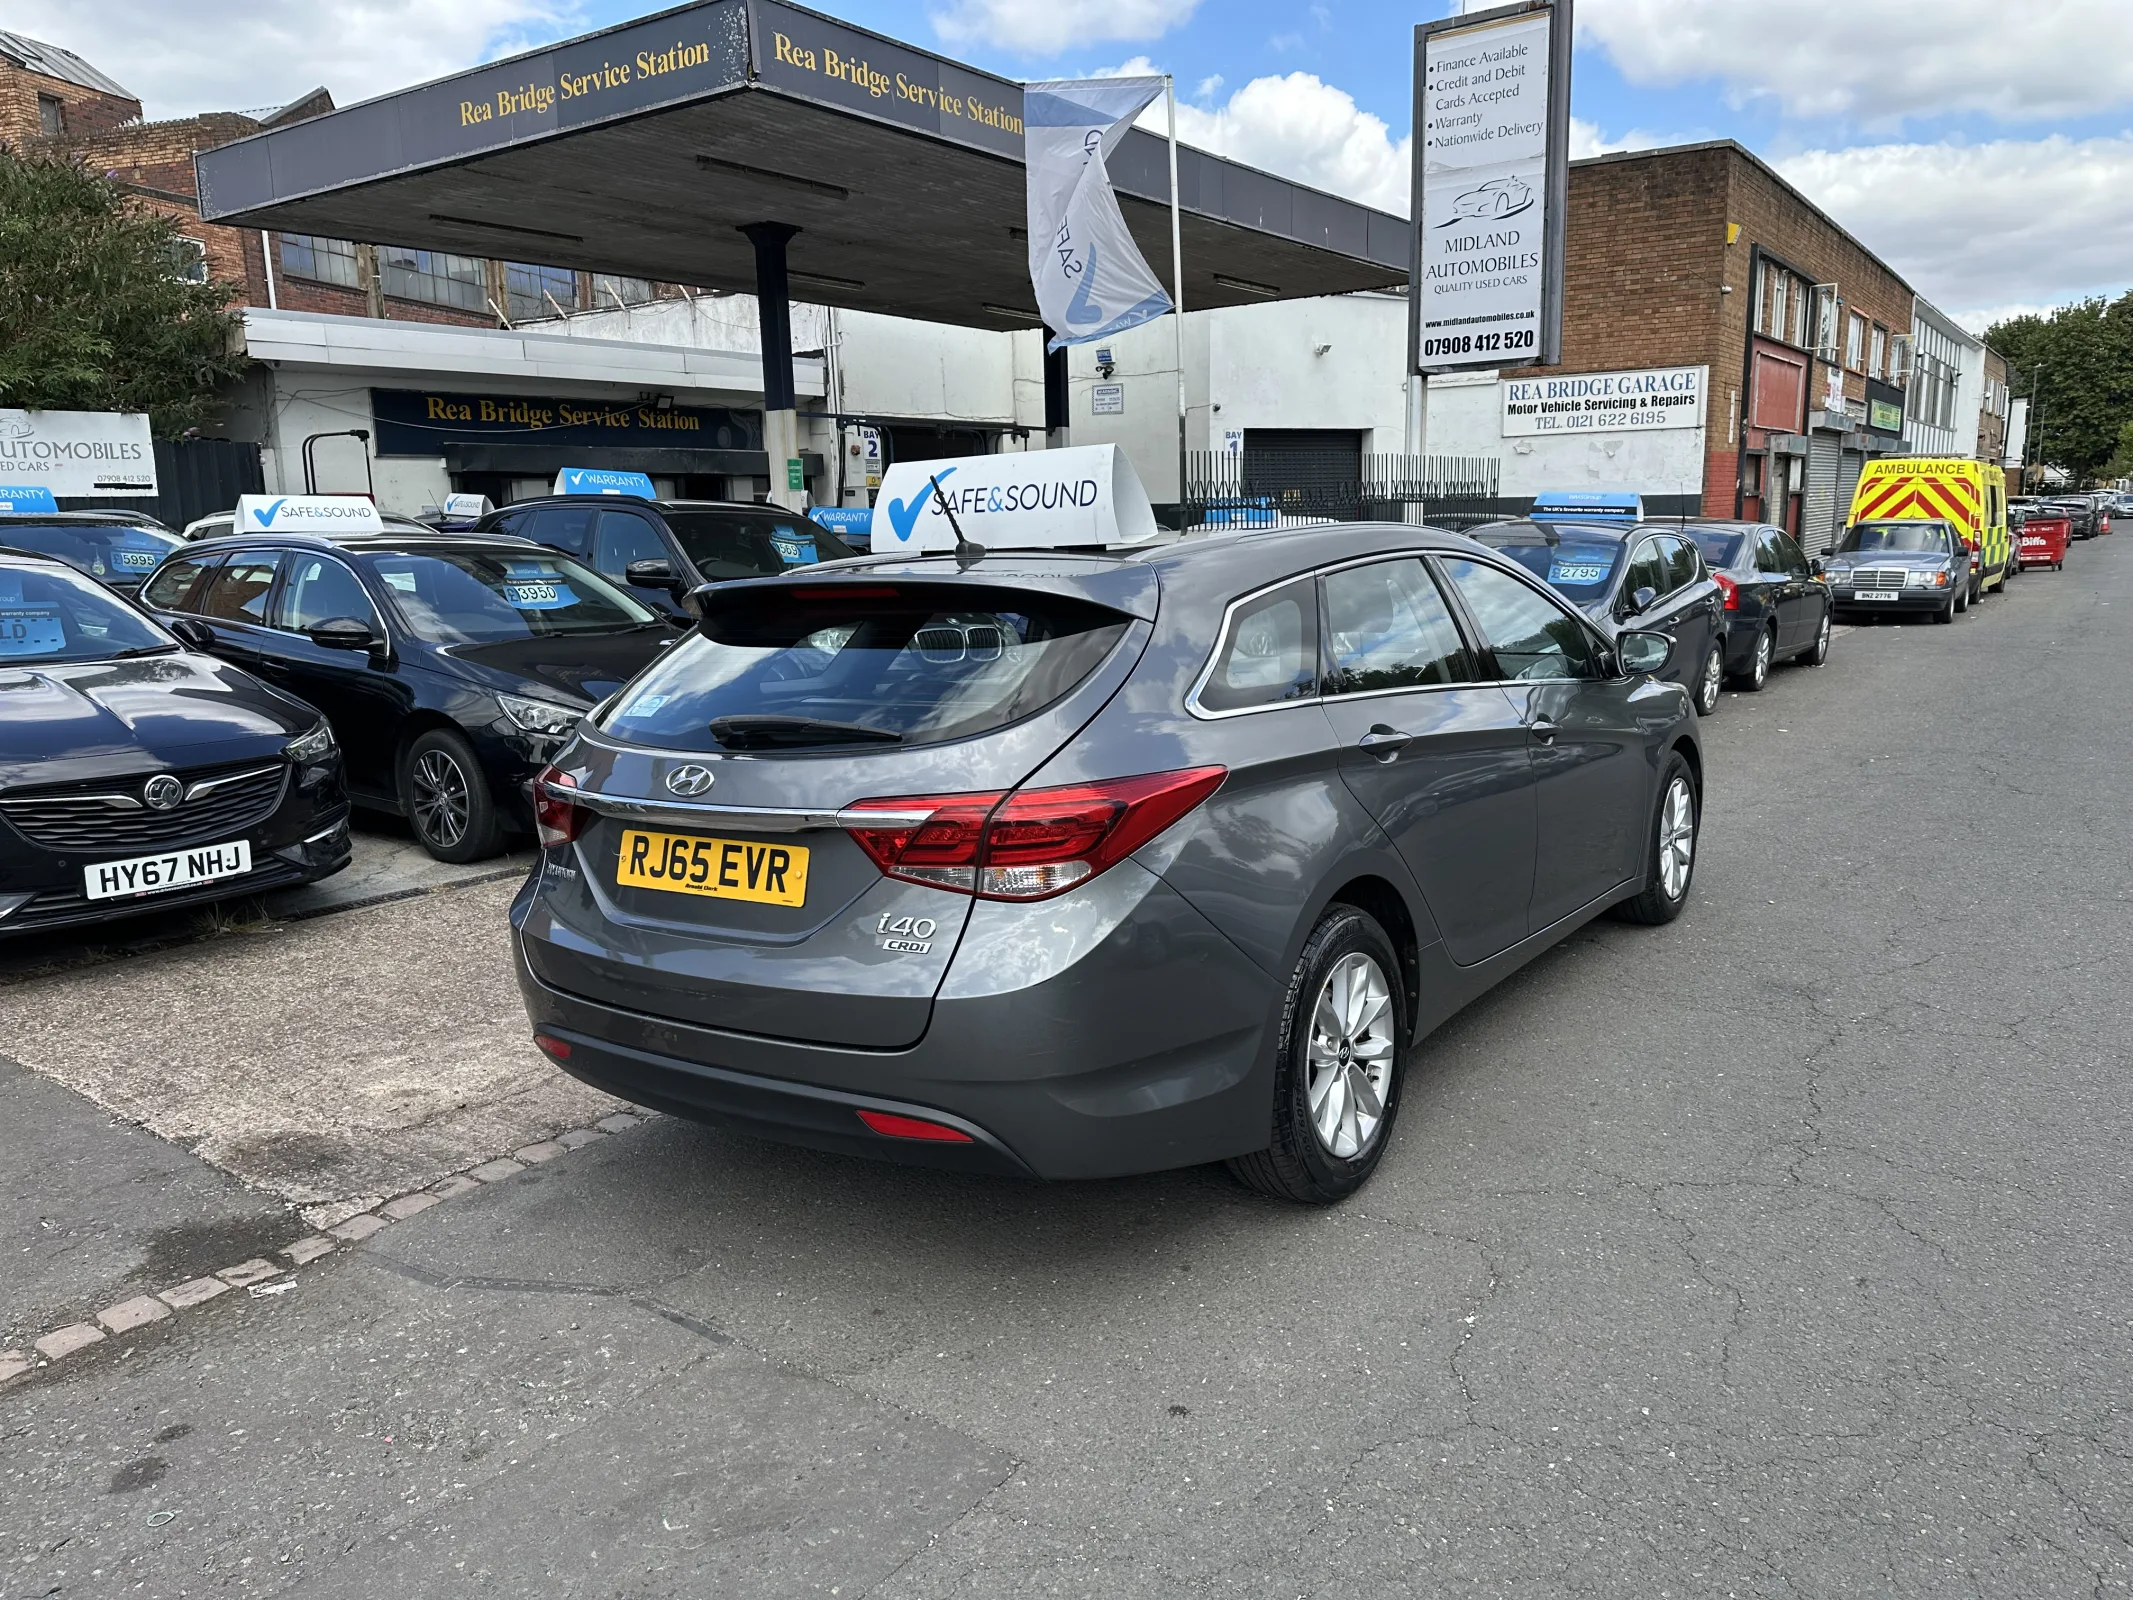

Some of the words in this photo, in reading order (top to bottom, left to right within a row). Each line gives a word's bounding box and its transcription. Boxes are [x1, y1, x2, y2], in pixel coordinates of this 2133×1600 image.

[1437, 56, 1476, 73] Finance
[1479, 44, 1528, 64] Available
[460, 101, 492, 126] Rea
[497, 84, 555, 114] Bridge
[560, 62, 630, 100] Service
[636, 41, 709, 80] Station
[773, 31, 817, 71] Rea
[823, 48, 890, 98] Bridge
[896, 72, 962, 116] Service
[967, 95, 1023, 135] Station
[1436, 75, 1468, 92] Credit
[1471, 70, 1491, 85] and
[1495, 64, 1525, 80] Debit
[1436, 95, 1465, 111] Cards
[1468, 84, 1520, 105] Accepted
[1435, 112, 1482, 130] Warranty
[1435, 128, 1494, 148] Nationwide
[1498, 122, 1543, 138] Delivery
[1444, 230, 1520, 254] MIDLAND
[1425, 252, 1538, 280] AUTOMOBILES
[1434, 281, 1473, 295] QUALITY
[1475, 278, 1500, 290] USED
[1503, 275, 1528, 286] CARS
[1425, 310, 1535, 329] www.midlandautomobiles.co.uk
[1424, 336, 1471, 356] 07908
[1475, 333, 1501, 352] 412
[1504, 330, 1534, 349] 520
[1509, 383, 1542, 401] REA
[1548, 378, 1614, 398] BRIDGE
[1618, 372, 1696, 394] GARAGE
[426, 397, 471, 421] Rea
[480, 400, 552, 428] Bridge
[559, 404, 630, 427] Service
[638, 408, 700, 430] Station
[1507, 403, 1538, 415] Motor
[1541, 399, 1581, 414] Vehicle
[1584, 397, 1636, 411] Servicing
[1639, 398, 1648, 407] &
[1651, 394, 1695, 408] Repairs
[1535, 417, 1563, 430] TEL.
[1567, 414, 1593, 428] 0121
[1598, 413, 1626, 426] 622
[1630, 411, 1666, 425] 6195
[864, 430, 879, 439] BAY
[1225, 431, 1242, 439] BAY
[868, 440, 878, 457] 2
[18, 461, 49, 471] CARS
[1874, 464, 1966, 474] AMBULANCE
[585, 473, 646, 487] WARRANTY
[931, 479, 1098, 516] SAFE&SOUND
[281, 506, 371, 518] SAFE&SOUND
[823, 512, 869, 522] WARRANTY
[2022, 536, 2046, 546] Biffa
[1551, 568, 1599, 579] £2795
[100, 857, 178, 893] HY67
[188, 847, 241, 878] NHJ
[630, 835, 712, 884] RJ65
[719, 843, 790, 893] EVR
[876, 912, 937, 939] i40
[888, 940, 926, 952] CRDi
